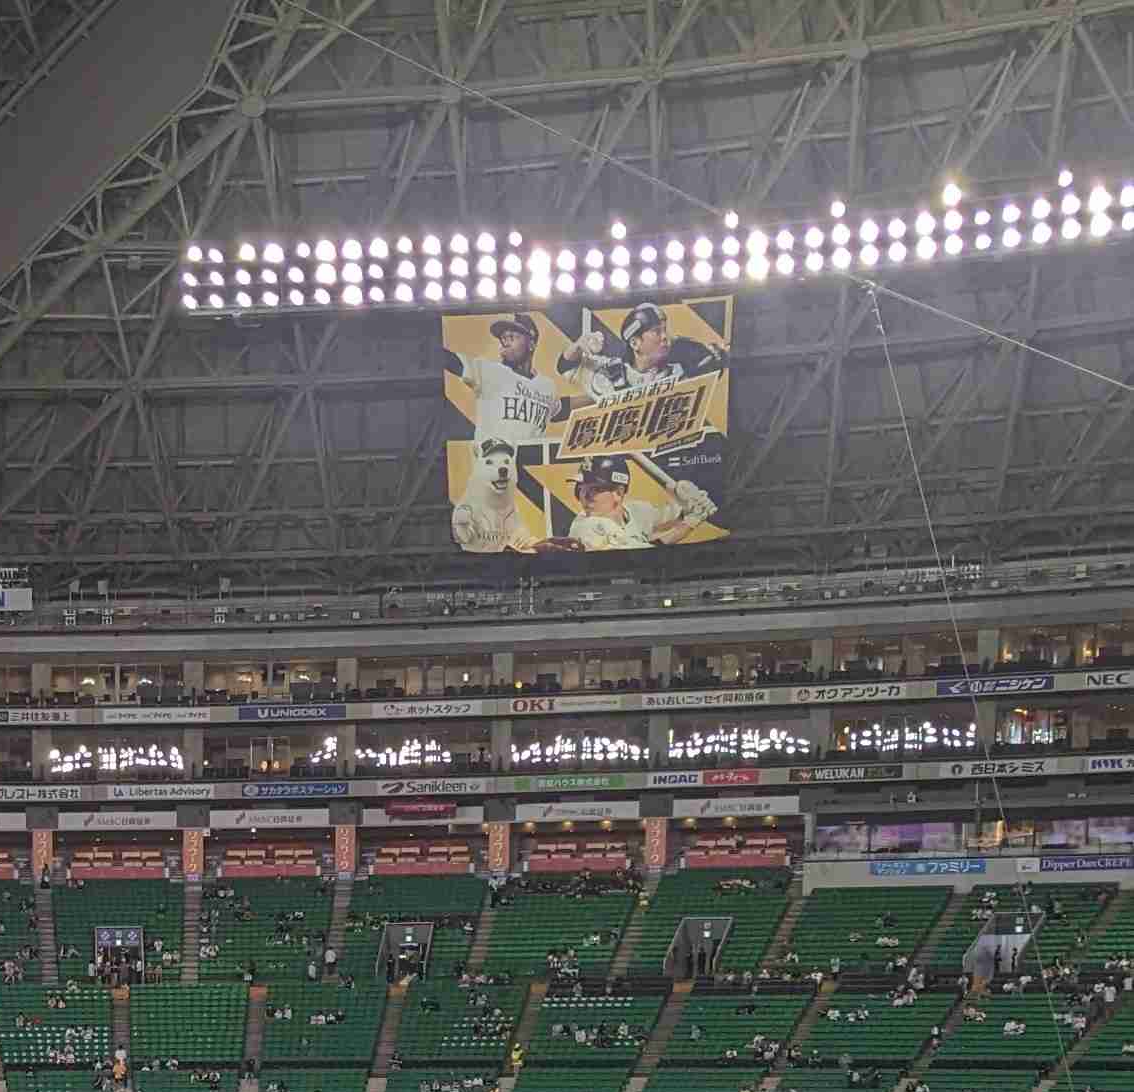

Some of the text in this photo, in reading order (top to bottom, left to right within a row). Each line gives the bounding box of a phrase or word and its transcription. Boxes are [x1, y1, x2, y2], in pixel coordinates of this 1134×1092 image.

[1086, 673, 1131, 686] NEC
[815, 686, 901, 699] オクアンツーカ
[407, 703, 471, 714] ホットスタッフ
[512, 699, 555, 712] OKI
[970, 761, 1045, 775] 西日本シミズ
[170, 785, 210, 798] Advisory
[406, 780, 467, 793] Sanikleen
